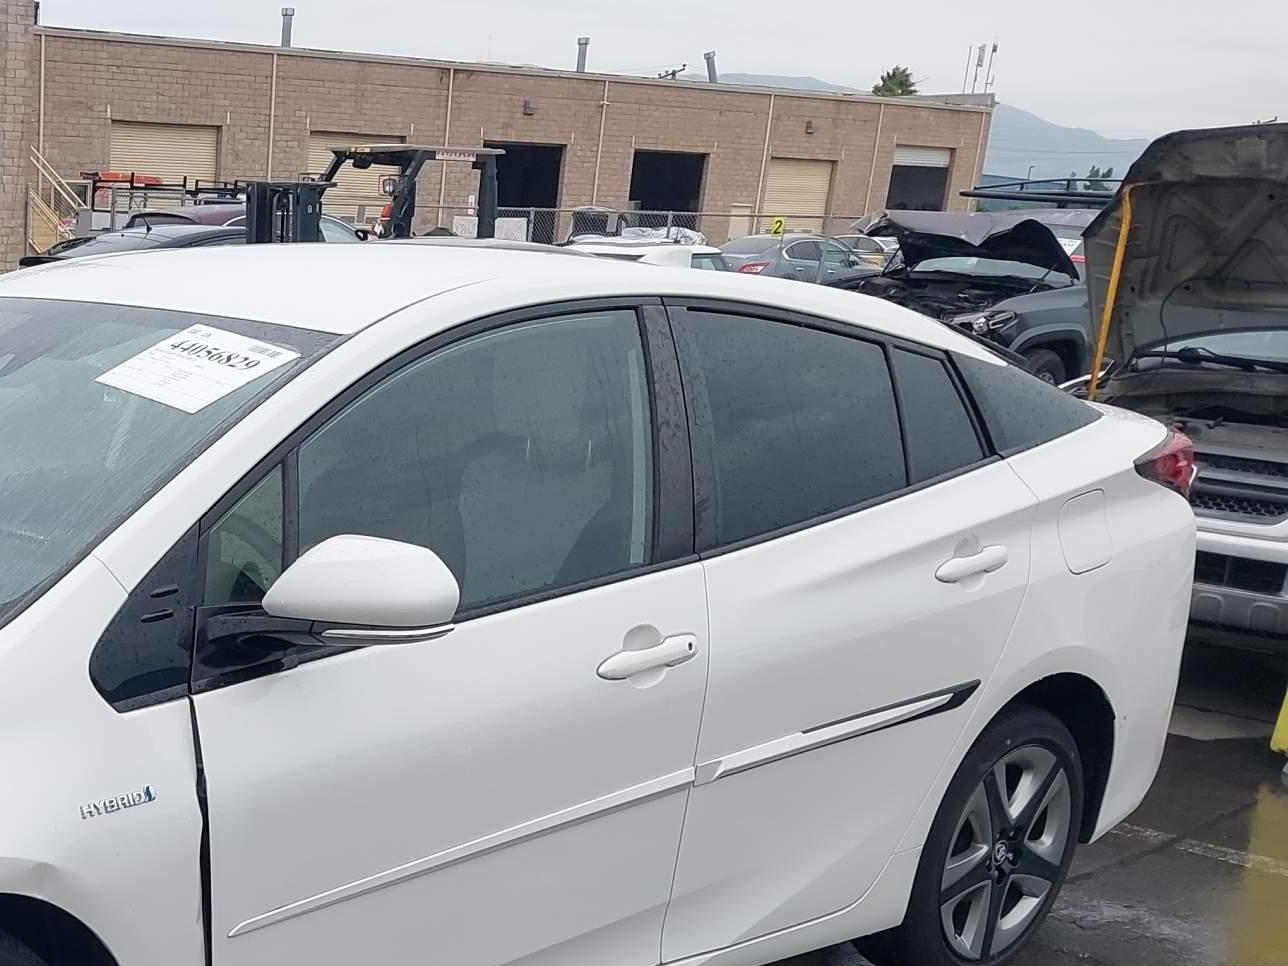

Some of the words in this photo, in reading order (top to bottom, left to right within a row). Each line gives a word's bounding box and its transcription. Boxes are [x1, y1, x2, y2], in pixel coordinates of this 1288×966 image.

[773, 219, 784, 235] 2
[170, 339, 261, 371] 44056829
[79, 791, 143, 820] HYBRID
